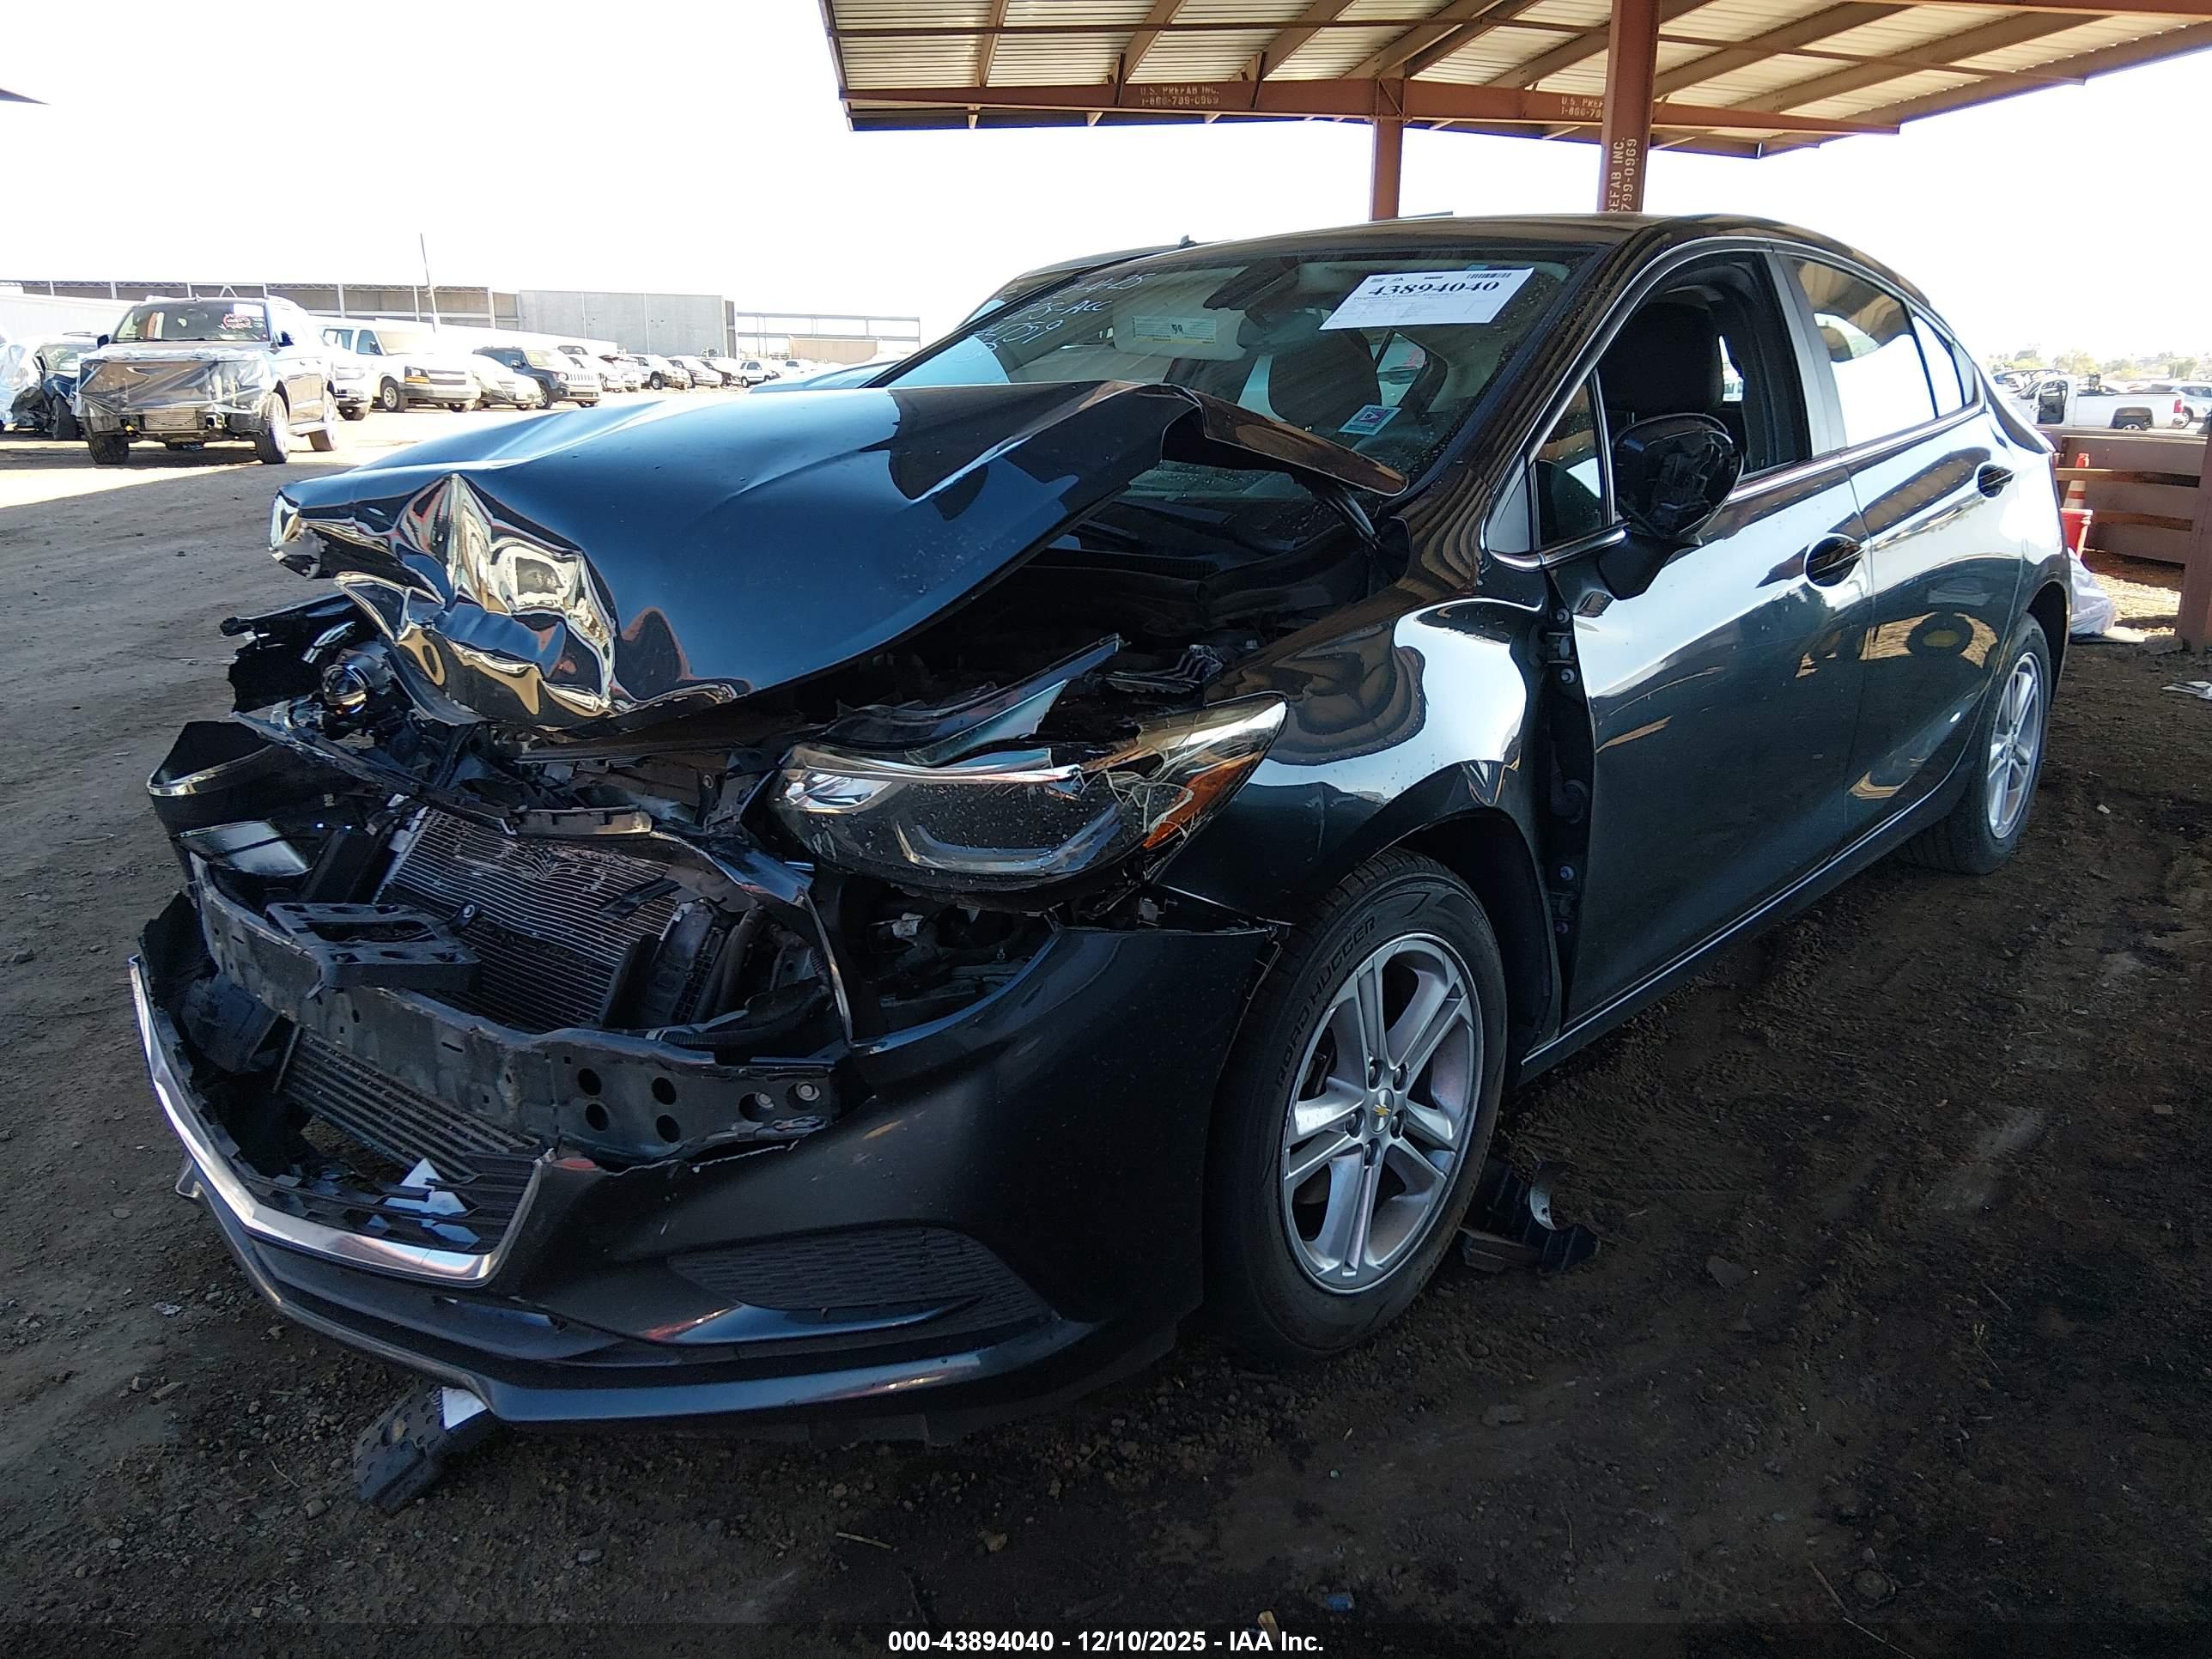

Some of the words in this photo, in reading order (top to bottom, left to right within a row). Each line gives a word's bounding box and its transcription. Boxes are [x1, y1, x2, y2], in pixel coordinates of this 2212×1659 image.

[1162, 85, 1199, 96] PREFAB
[1613, 137, 1625, 165] INC.
[1367, 280, 1501, 296] 43894040
[1309, 915, 1376, 1006] HUGGER
